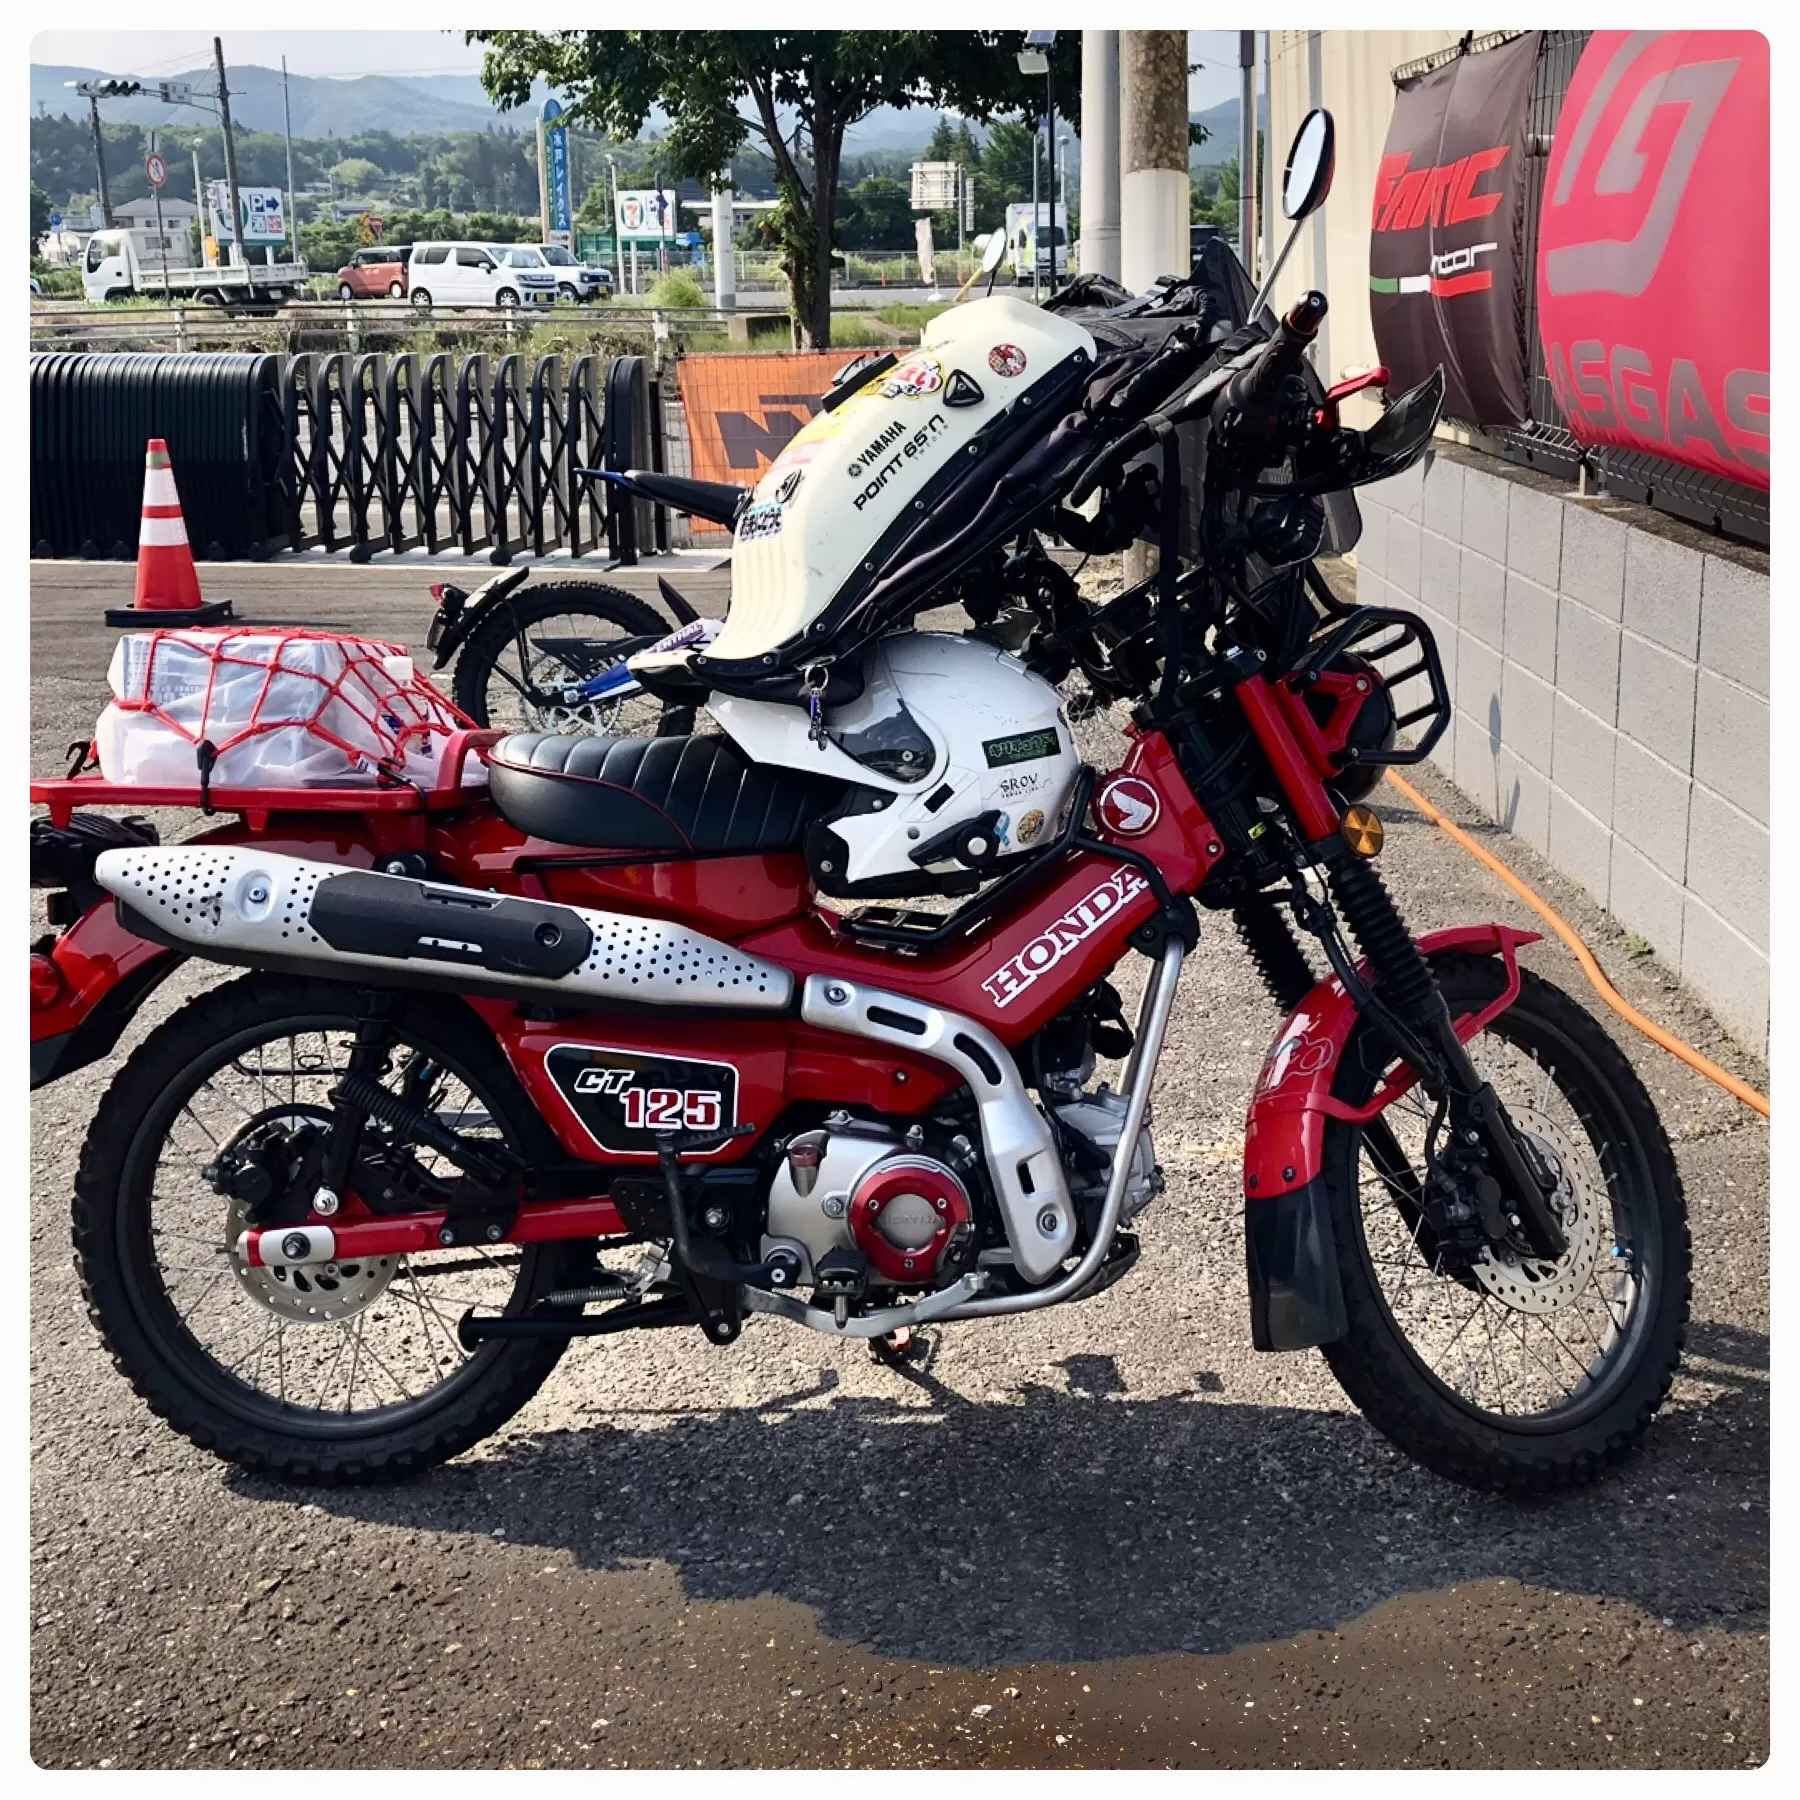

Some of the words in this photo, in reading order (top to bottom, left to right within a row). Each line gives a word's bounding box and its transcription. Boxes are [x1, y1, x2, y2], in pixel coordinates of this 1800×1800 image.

[552, 130, 567, 227] 水戸レイクス
[857, 420, 907, 467] YAMAHA
[981, 863, 1150, 1008] HONDA
[574, 1068, 635, 1094] CT
[619, 1087, 722, 1131] 125
